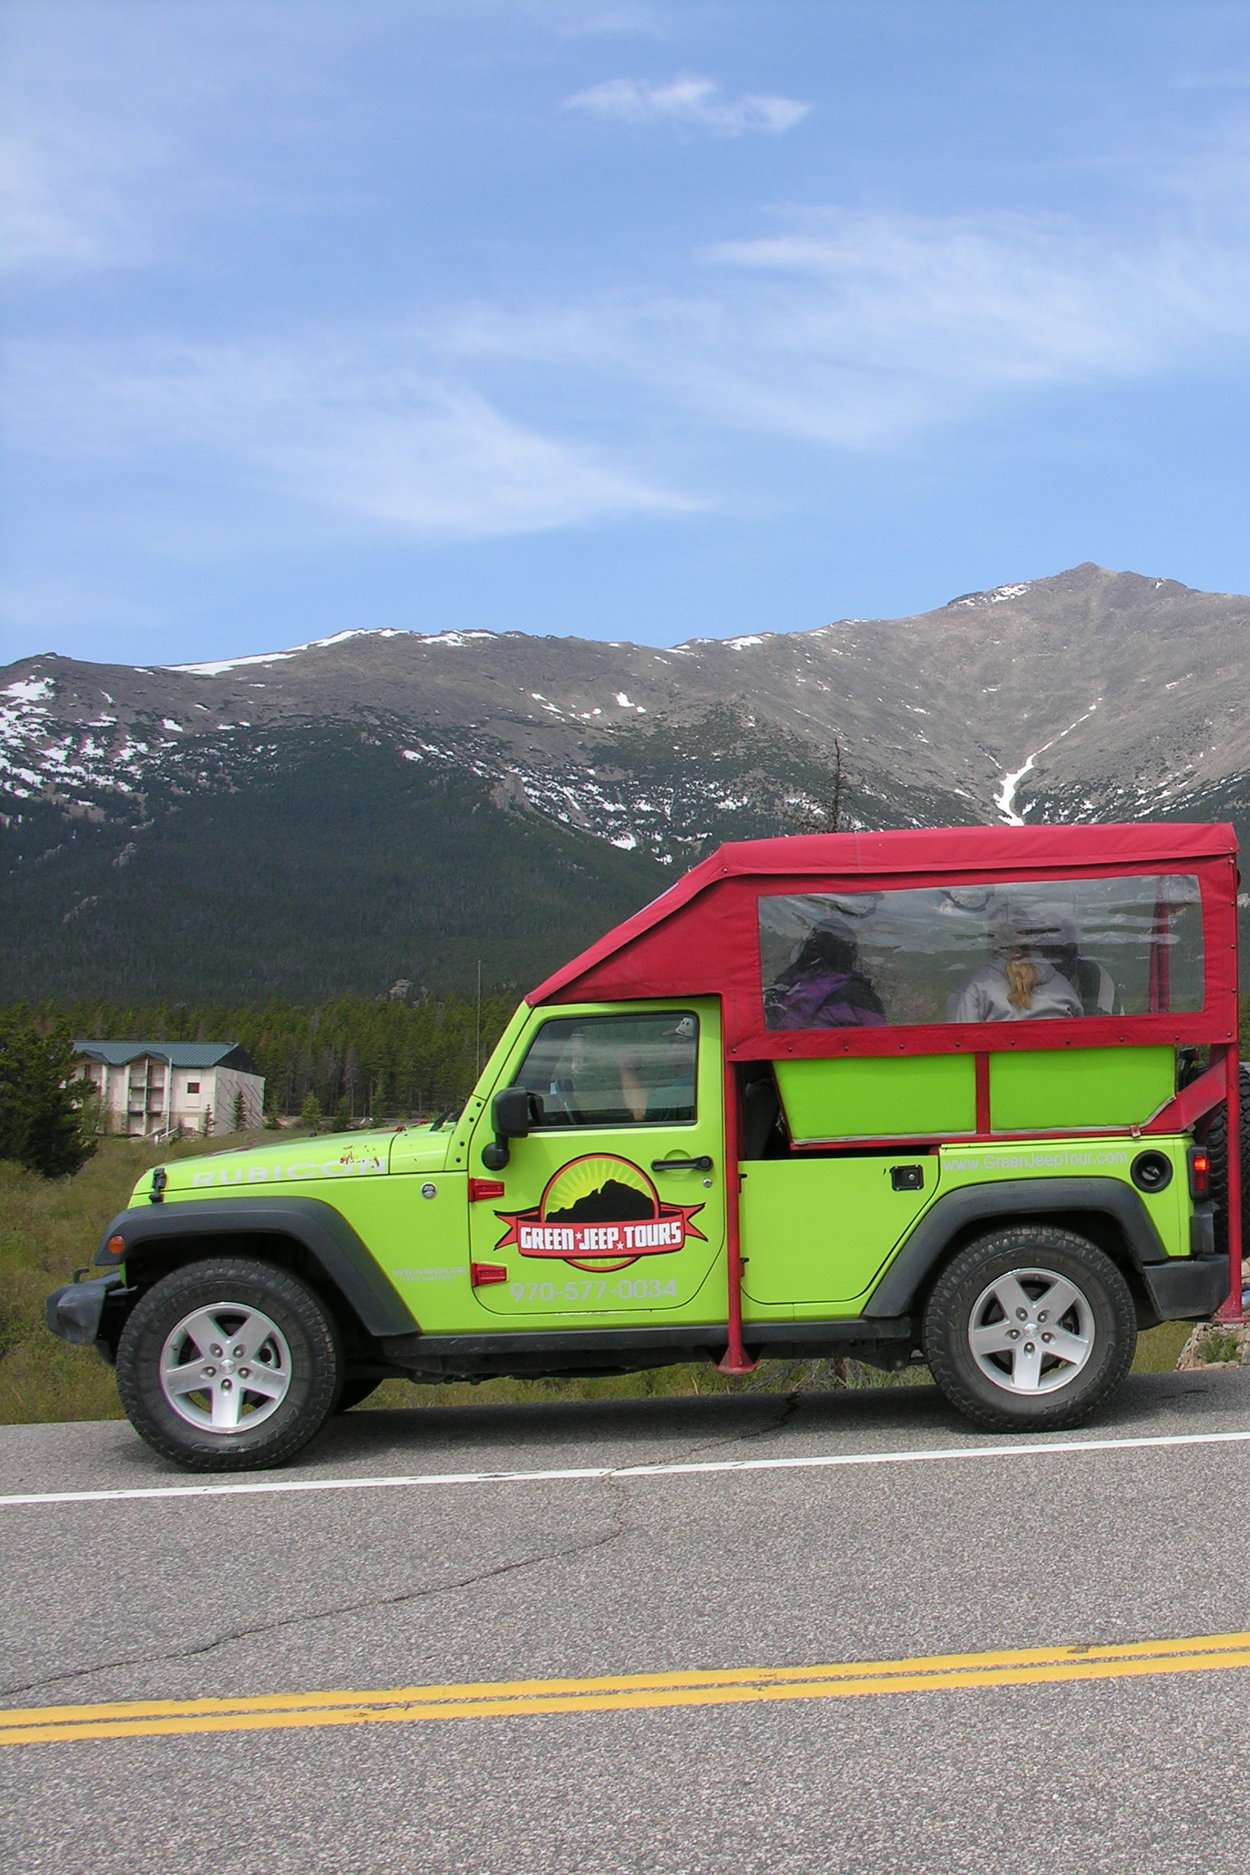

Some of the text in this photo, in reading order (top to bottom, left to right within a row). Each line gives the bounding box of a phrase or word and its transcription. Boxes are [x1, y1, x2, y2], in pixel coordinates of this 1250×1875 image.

[192, 1157, 386, 1187] RUBICON
[520, 1222, 681, 1250] GREEN JEEP TOURS
[510, 1279, 677, 1302] 970-577-0034
